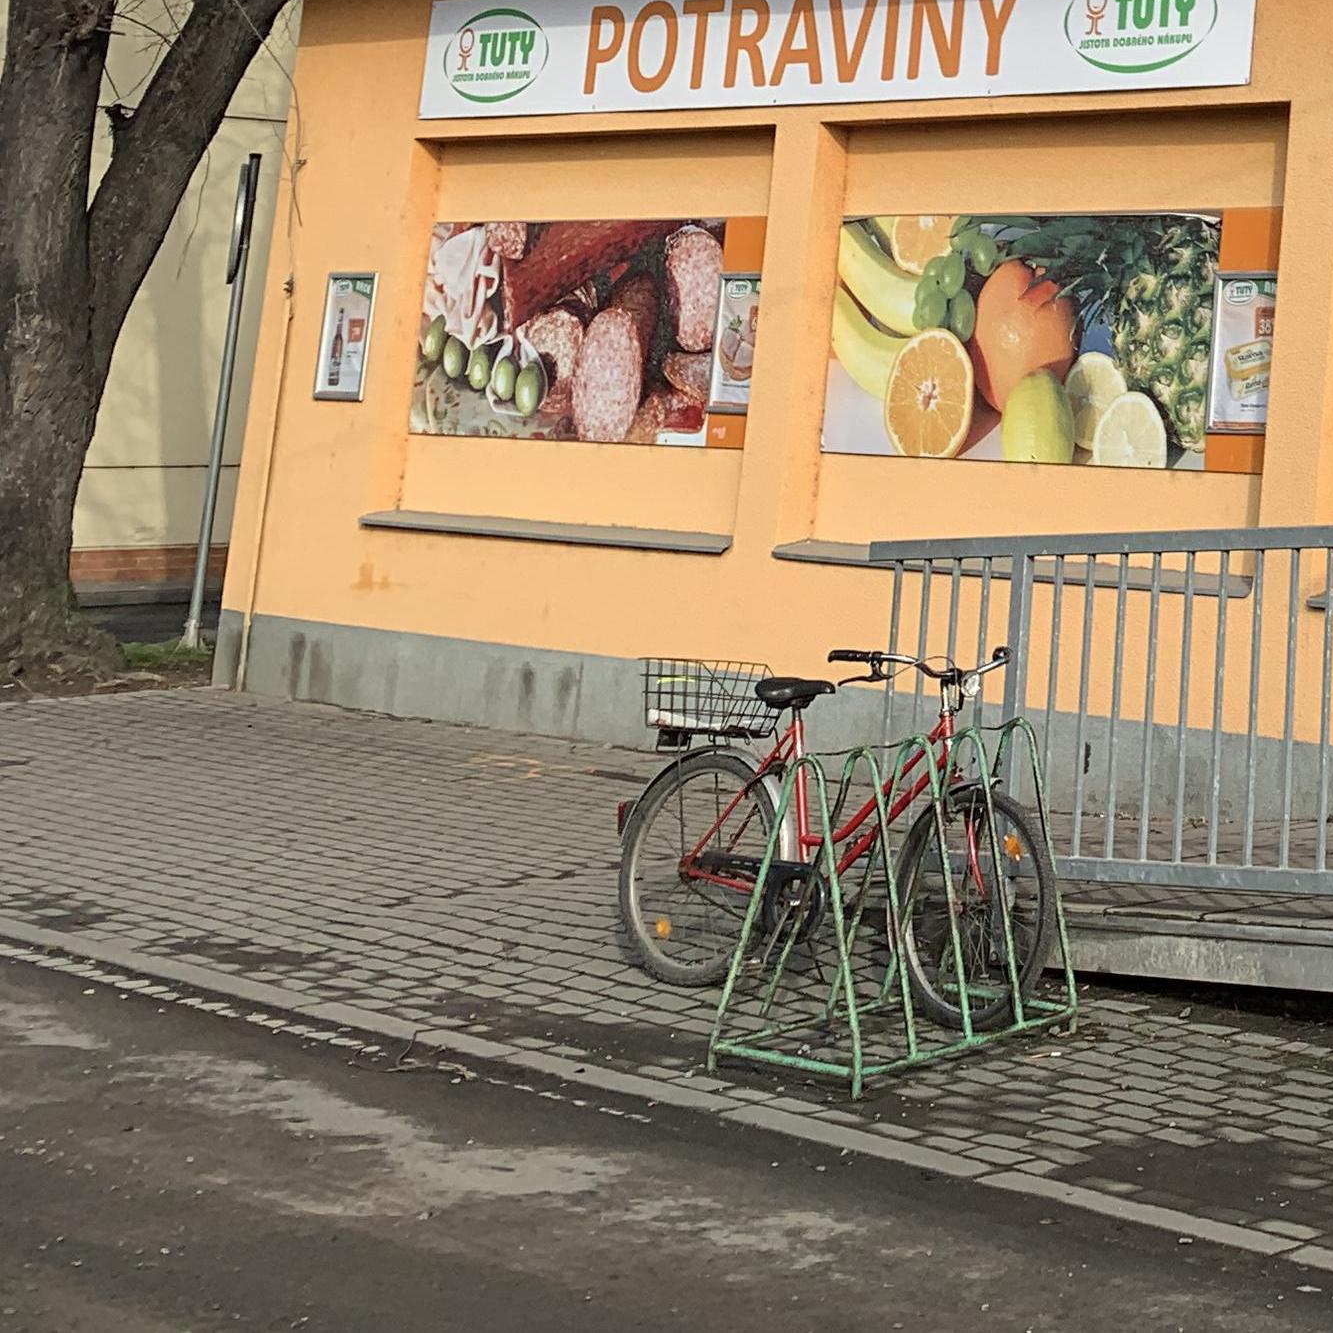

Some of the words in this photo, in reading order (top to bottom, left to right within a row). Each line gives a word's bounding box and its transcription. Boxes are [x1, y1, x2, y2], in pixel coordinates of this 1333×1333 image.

[479, 30, 537, 67] TUTY
[1079, 38, 1111, 49] JISTOTA
[1157, 33, 1193, 45] NÁKUPU
